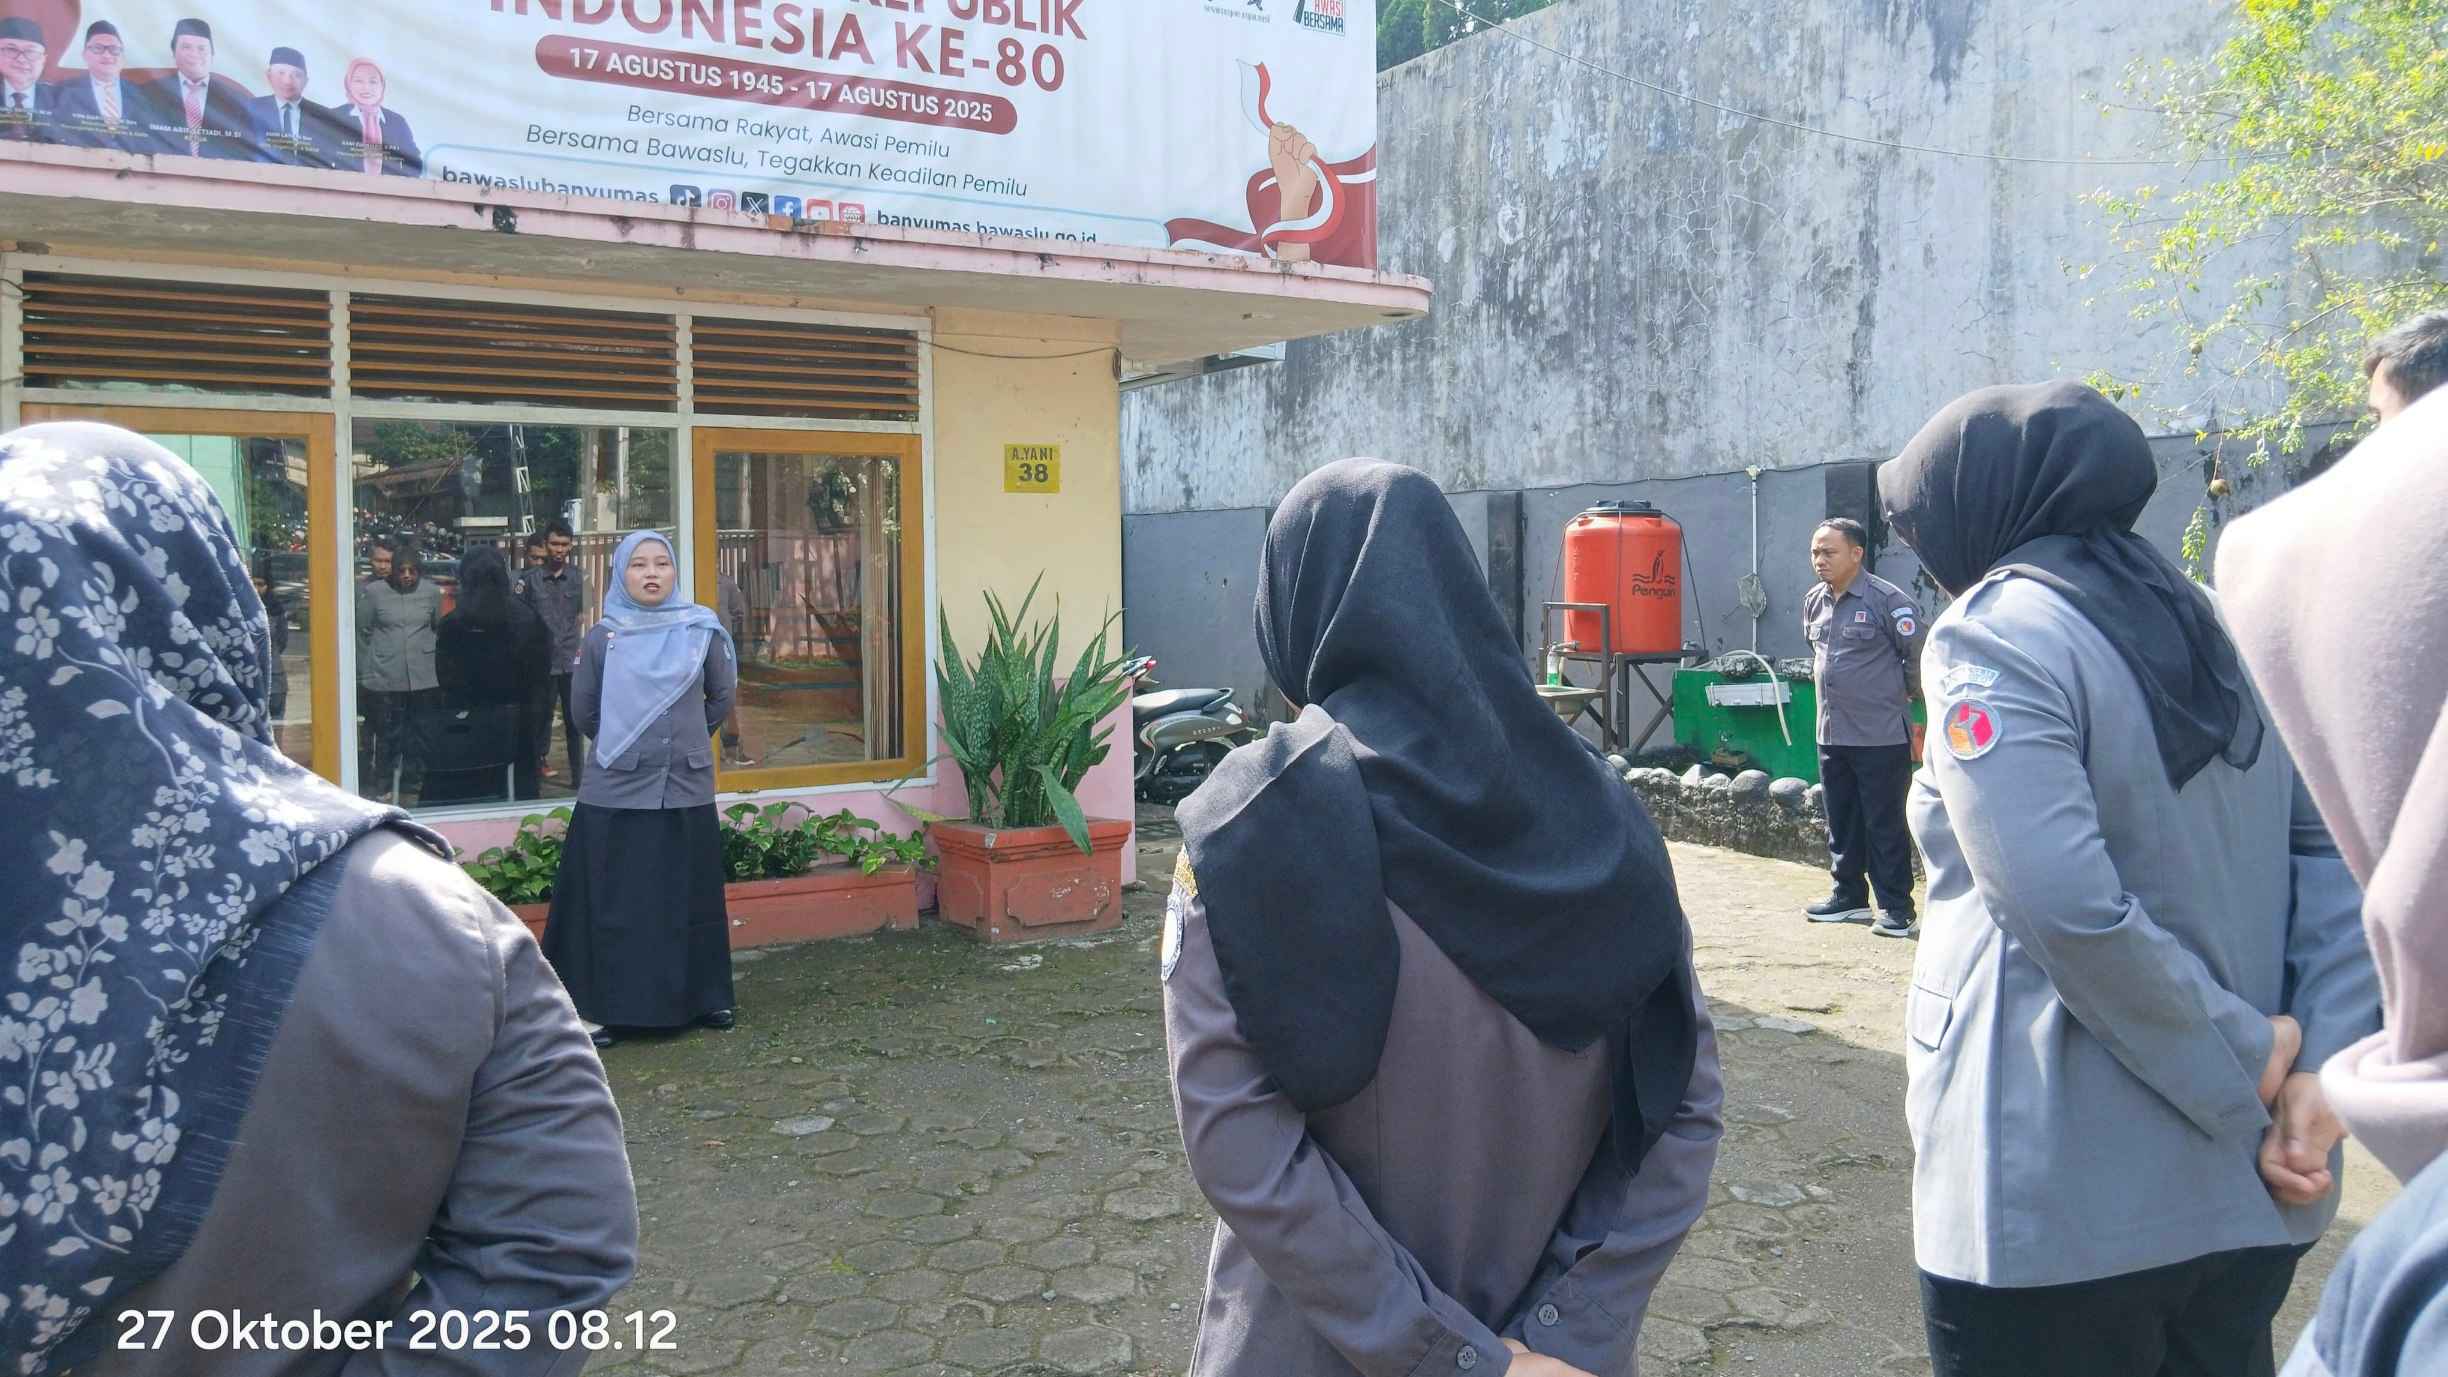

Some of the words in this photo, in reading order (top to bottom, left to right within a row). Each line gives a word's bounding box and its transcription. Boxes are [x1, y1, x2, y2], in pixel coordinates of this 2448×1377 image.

[490, 0, 875, 64] DONESIA
[895, 21, 1065, 92] KE-80
[850, 0, 1088, 40] BLIK
[1303, 11, 1345, 32] BERSAMA
[569, 48, 599, 70] 17
[605, 50, 723, 87] AGUSTUS
[729, 70, 784, 96] 1945
[805, 80, 833, 102] 17
[838, 84, 939, 115] AGUSTUS
[944, 99, 993, 122] 2025
[627, 104, 729, 132] Bersama
[735, 118, 814, 144] Rakyat,
[819, 127, 879, 150] Awasi
[884, 136, 950, 159] Pemilu
[526, 124, 639, 154] Bersama
[646, 138, 749, 168] Bawaslu,
[758, 150, 862, 178] Tegakkan
[868, 164, 957, 190] Keadilan
[962, 174, 1028, 198] Pemilu
[1018, 462, 1049, 482] 38
